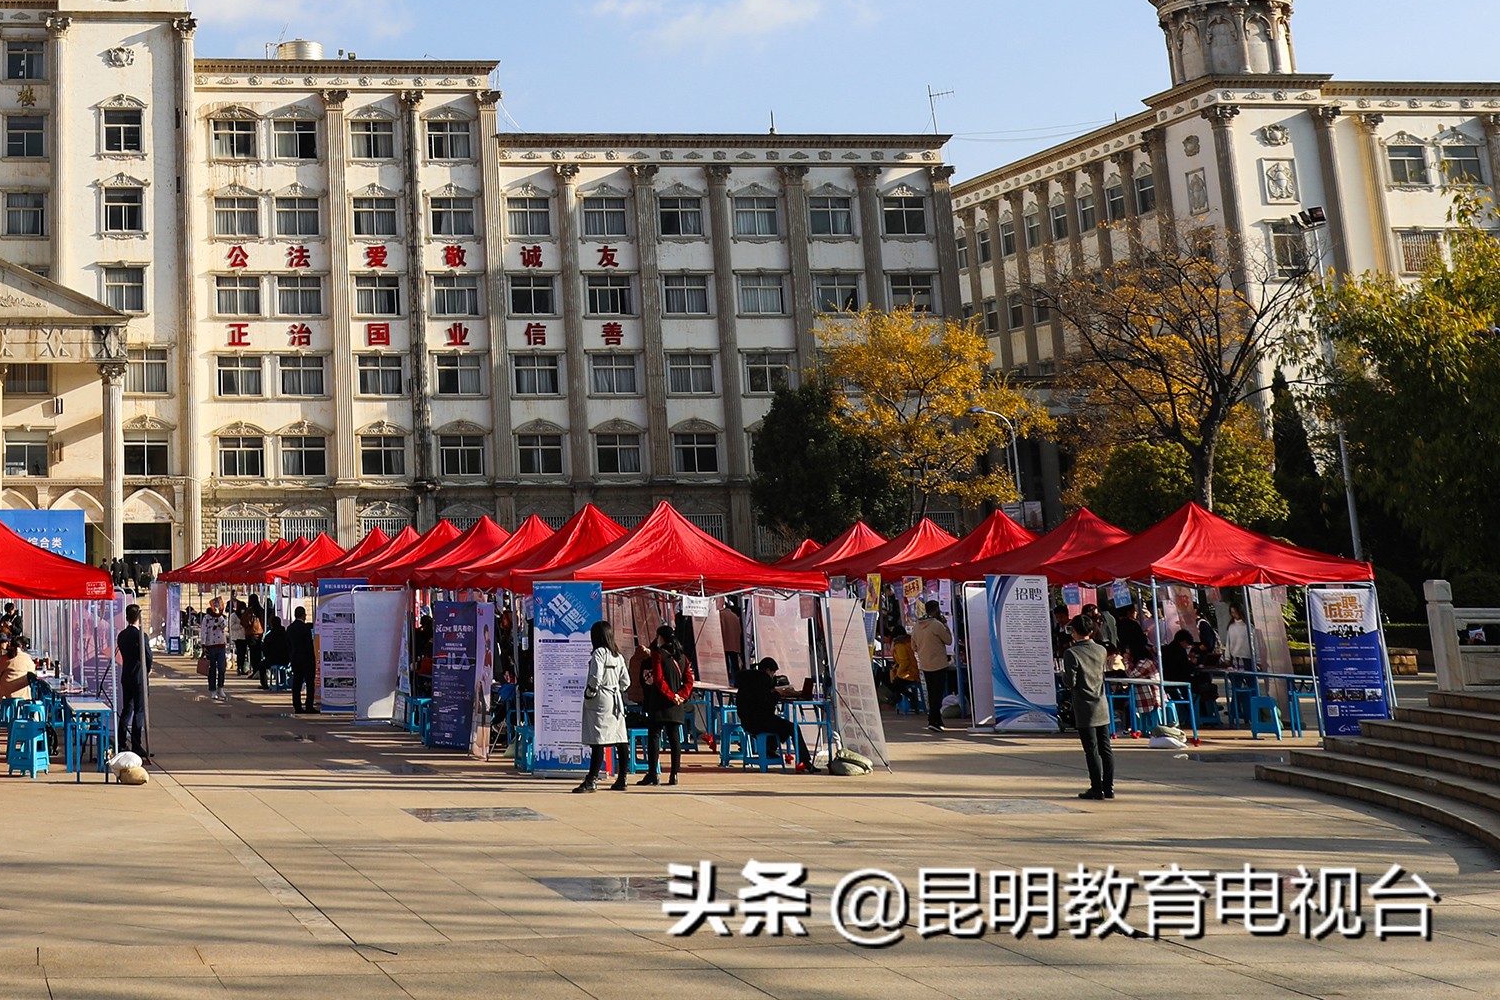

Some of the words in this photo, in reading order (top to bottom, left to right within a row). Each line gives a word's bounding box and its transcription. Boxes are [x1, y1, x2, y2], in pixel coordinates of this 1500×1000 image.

[27, 537, 62, 549] 综合类
[1015, 587, 1042, 601] 招聘
[547, 593, 587, 632] 招聘
[436, 652, 471, 670] FILA
